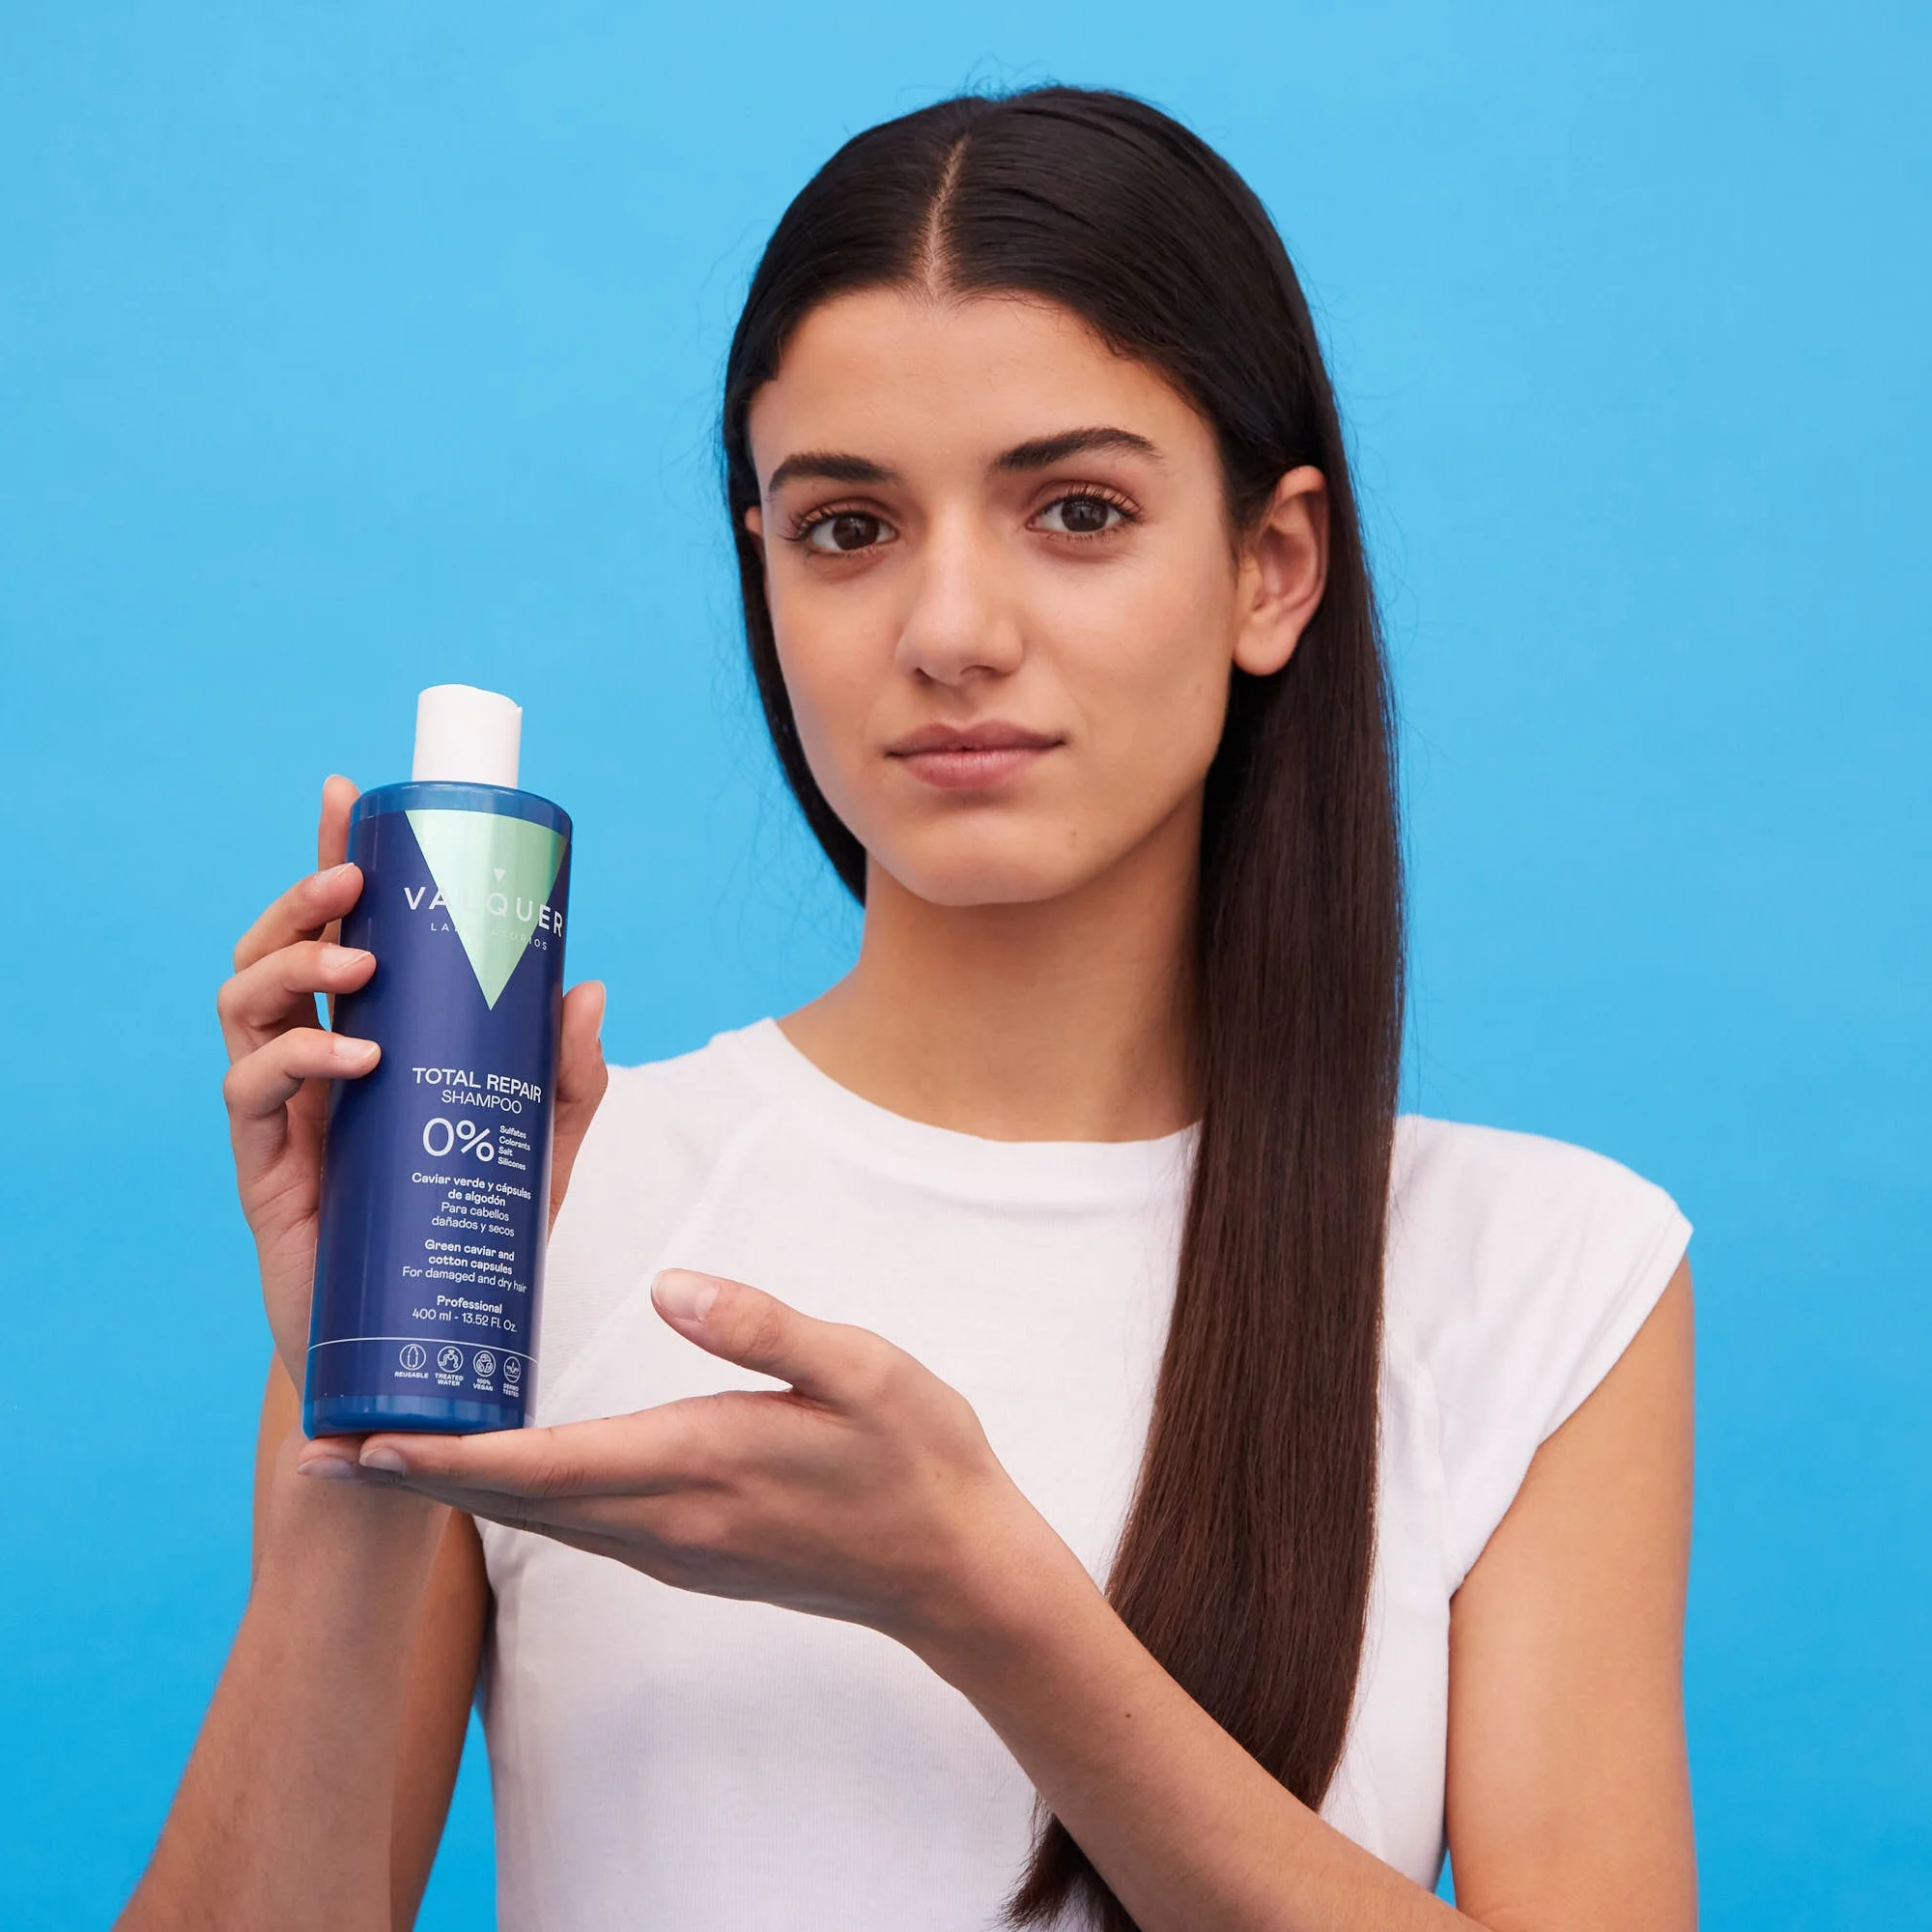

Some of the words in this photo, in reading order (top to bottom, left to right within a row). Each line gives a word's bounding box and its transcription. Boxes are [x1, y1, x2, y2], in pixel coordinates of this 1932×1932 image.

[404, 887, 562, 937] VAQUER
[412, 1067, 481, 1089] TOTAL
[487, 1074, 542, 1103] REPAIR
[441, 1090, 522, 1114] SHAMPOO
[423, 1118, 495, 1162] 0%
[499, 1125, 526, 1139] Sulfates
[498, 1147, 513, 1157] Salt
[499, 1137, 530, 1151] Colorants
[497, 1157, 526, 1171] Silicones
[412, 1173, 450, 1184] Caviar
[454, 1178, 485, 1189] verde
[488, 1182, 494, 1192] y
[496, 1182, 531, 1200] cápsulas
[448, 1189, 462, 1200] de
[466, 1191, 506, 1207] algodón
[441, 1202, 467, 1214] Para
[470, 1208, 509, 1221] cabellos
[432, 1215, 477, 1231] dañados
[480, 1223, 487, 1233] y
[489, 1225, 515, 1237] secos
[425, 1239, 461, 1252] Green
[464, 1244, 497, 1257] caviar
[498, 1251, 515, 1262] and
[429, 1255, 468, 1267] cotton
[470, 1260, 513, 1275] capsules
[403, 1266, 422, 1277] For
[425, 1268, 475, 1283] damaged
[478, 1274, 496, 1286] and
[497, 1279, 512, 1291] dry
[514, 1281, 526, 1293] hair
[437, 1295, 502, 1314] Professional
[412, 1308, 436, 1320] 400
[440, 1311, 451, 1321] ml
[462, 1313, 488, 1326] 13.52
[491, 1318, 501, 1329] Fl.
[394, 1371, 429, 1379] REUSABLE
[436, 1373, 464, 1381] TREATED
